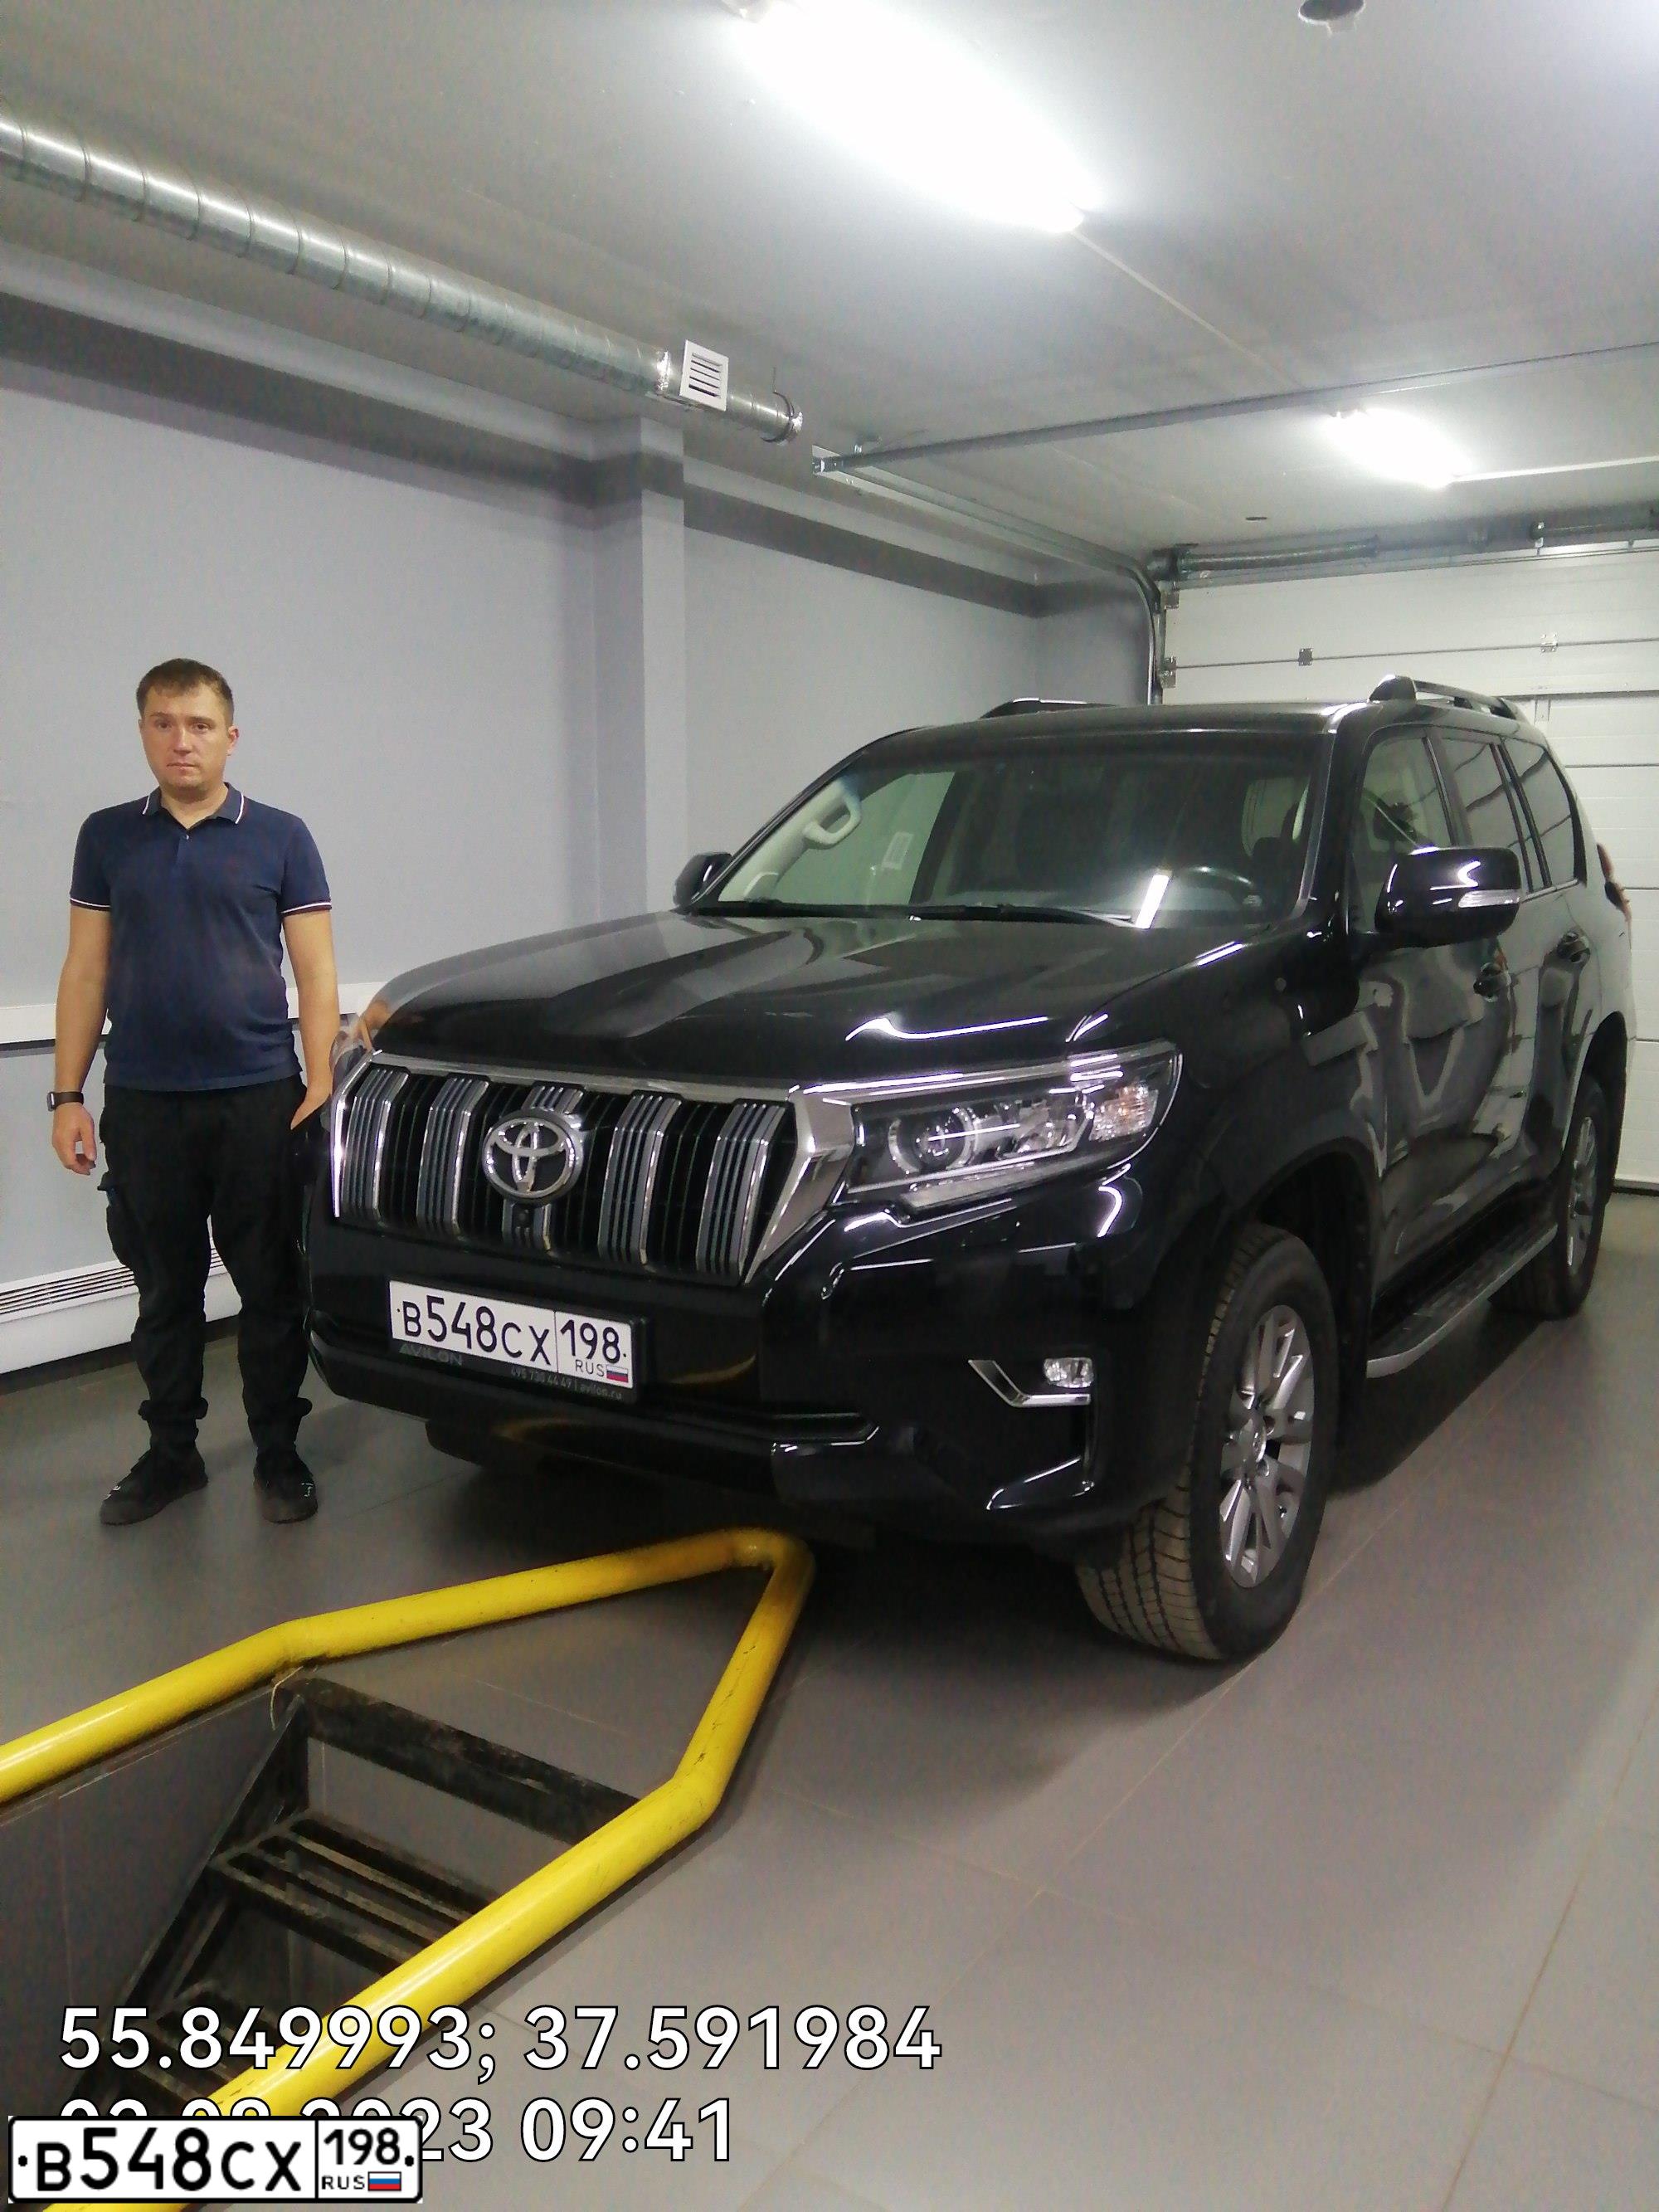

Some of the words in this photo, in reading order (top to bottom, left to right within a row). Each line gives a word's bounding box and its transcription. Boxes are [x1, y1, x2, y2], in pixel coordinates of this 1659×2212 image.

[402, 1294, 551, 1365] В548СХ
[560, 1319, 621, 1364] 198
[575, 1359, 605, 1377] RUS
